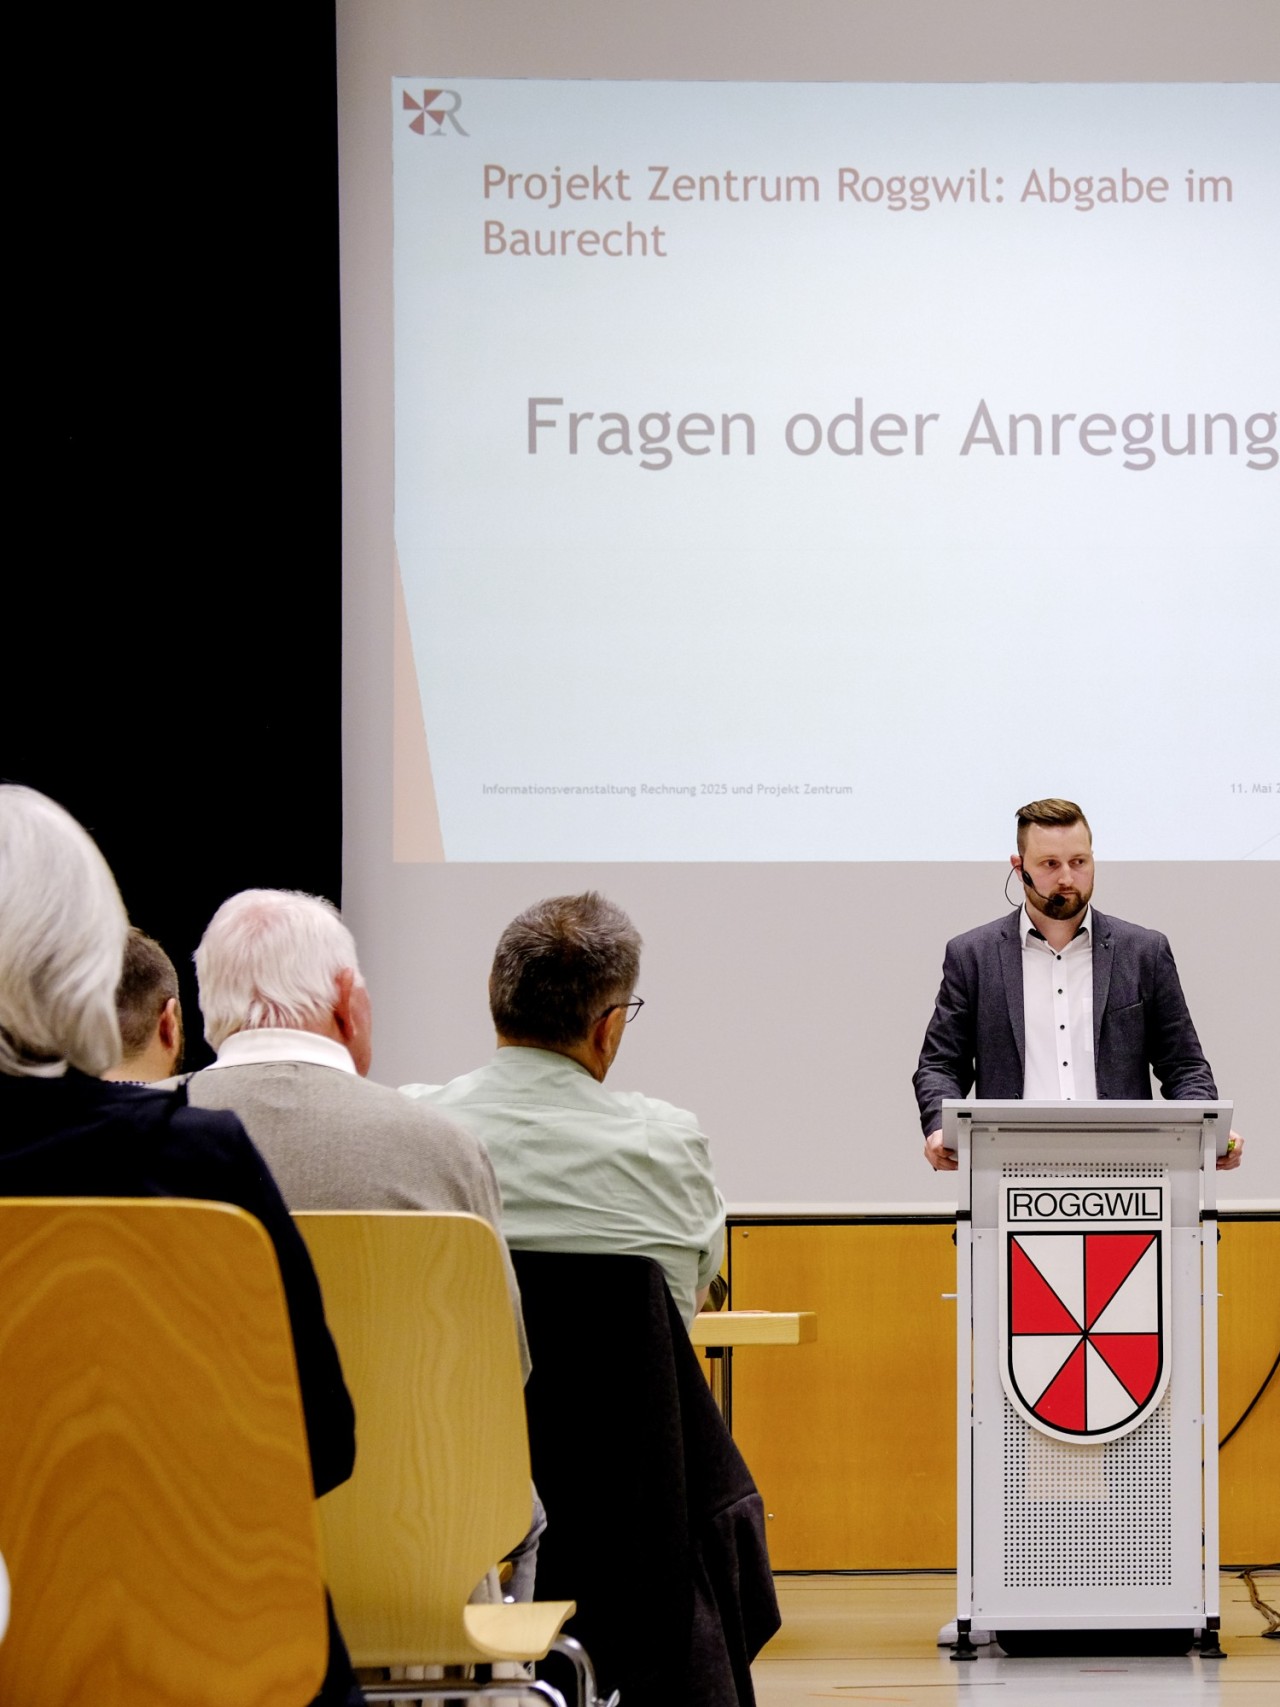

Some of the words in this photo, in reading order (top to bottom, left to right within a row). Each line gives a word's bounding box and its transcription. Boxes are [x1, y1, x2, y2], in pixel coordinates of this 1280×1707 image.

[482, 163, 632, 210] Projekt
[647, 165, 820, 203] Zentrum
[838, 166, 1005, 212] Roggwil:
[1019, 166, 1170, 213] Abgabe
[1184, 168, 1234, 203] im
[482, 219, 668, 258] Baurecht
[526, 396, 757, 472] Fragen
[784, 396, 941, 457] oder
[482, 783, 637, 798] Informationsveranstaltung
[640, 783, 697, 798] Rechnung
[700, 783, 728, 796] 2025
[731, 783, 754, 796] und
[756, 782, 801, 798] Projekt
[803, 783, 854, 796] Zentrum
[1230, 782, 1248, 795] 11.
[1251, 782, 1273, 795] Mai
[1013, 1192, 1159, 1217] ROGGWIL
